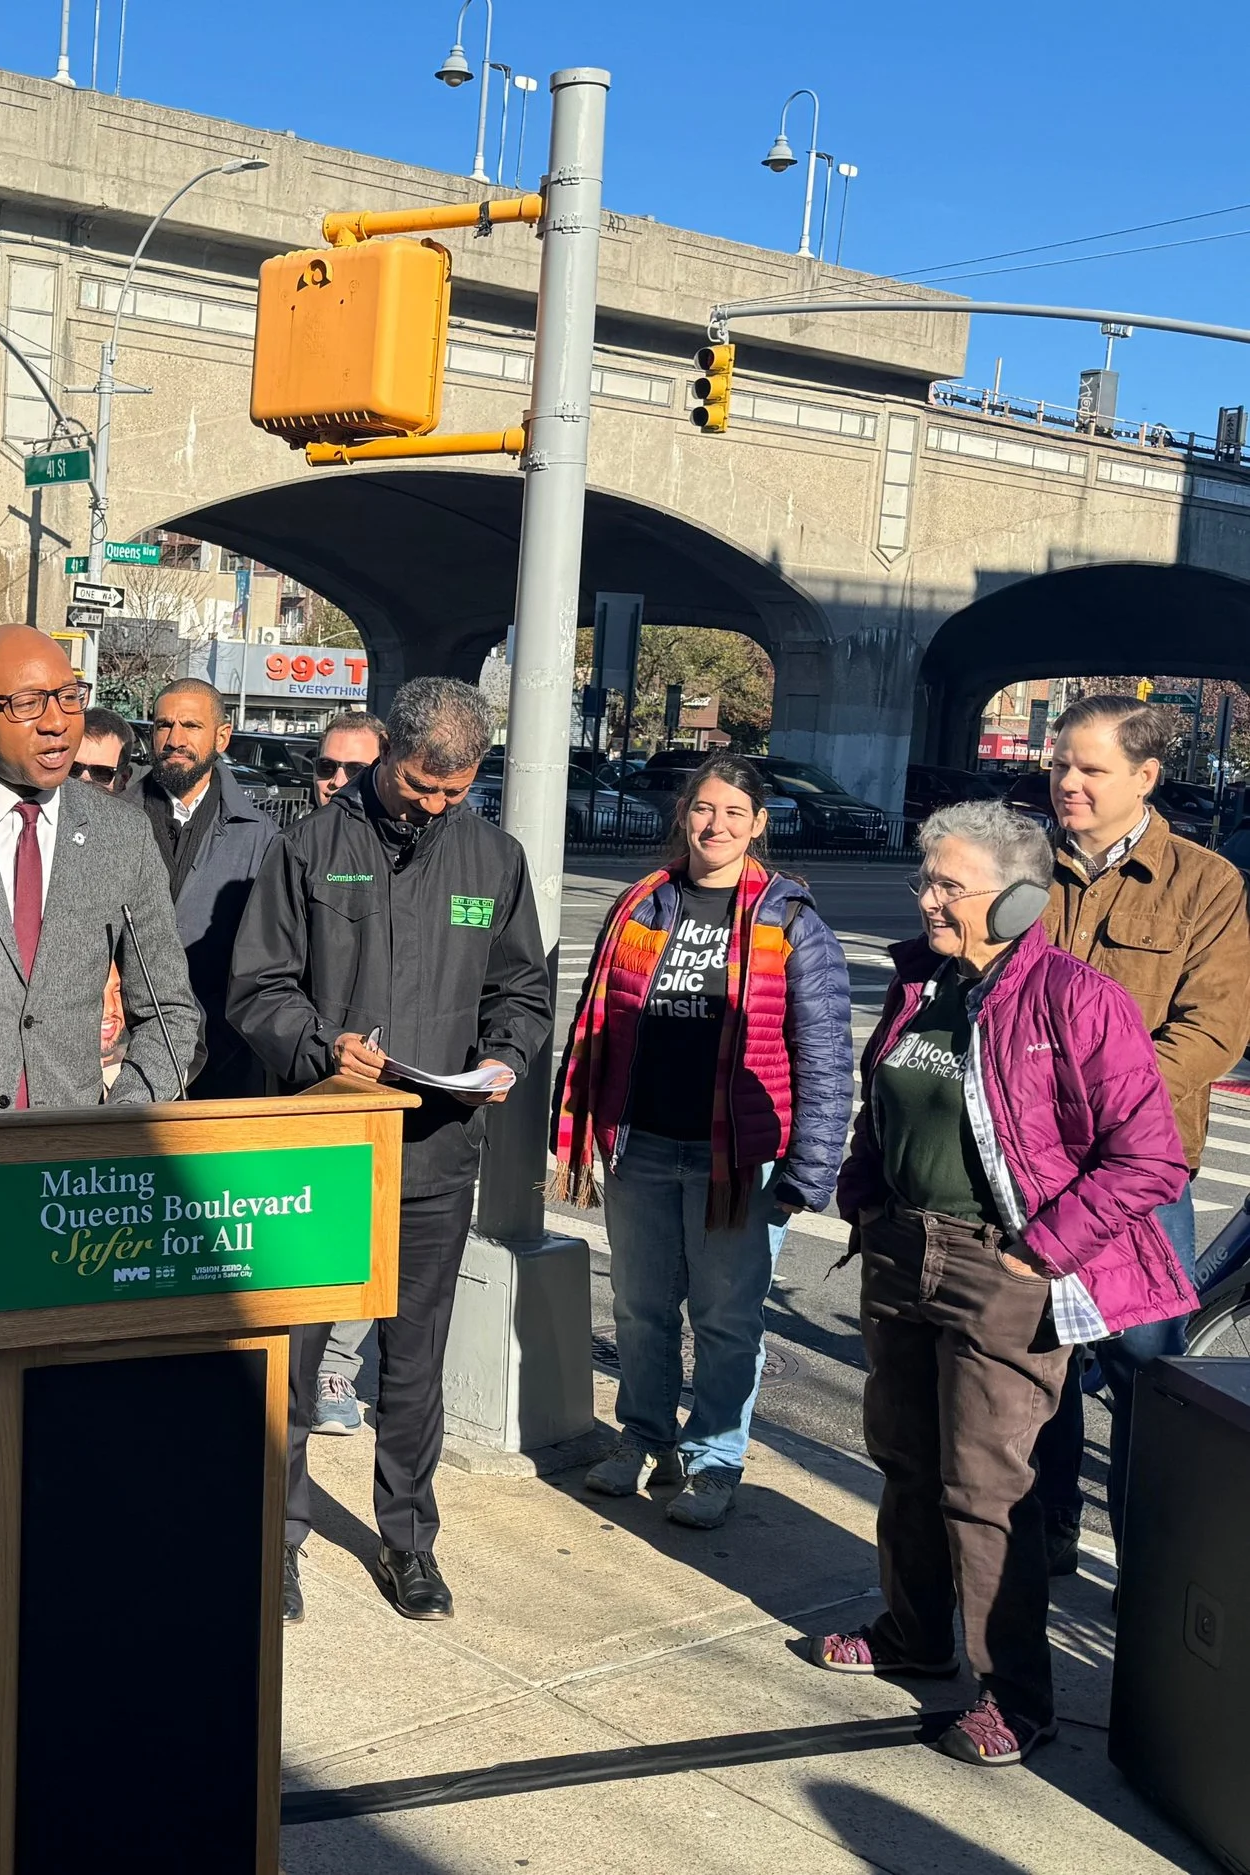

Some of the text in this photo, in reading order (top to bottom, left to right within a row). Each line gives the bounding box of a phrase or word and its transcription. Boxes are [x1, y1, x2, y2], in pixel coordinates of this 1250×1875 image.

[46, 459, 66, 478] 41 St
[106, 543, 156, 560] Queens Blvd
[80, 589, 118, 602] ONE WAY
[88, 613, 100, 623] WAY
[326, 873, 374, 882] Commissioner
[906, 1056, 929, 1071] ON
[931, 1062, 953, 1078] THE
[40, 1166, 155, 1200] Making
[40, 1185, 313, 1235] Queens Boulevard
[51, 1222, 254, 1276] Safer for All
[113, 1266, 151, 1283] NYC
[194, 1264, 242, 1274] VISION ZERO
[222, 1271, 240, 1279] Safer
[240, 1270, 253, 1278] City
